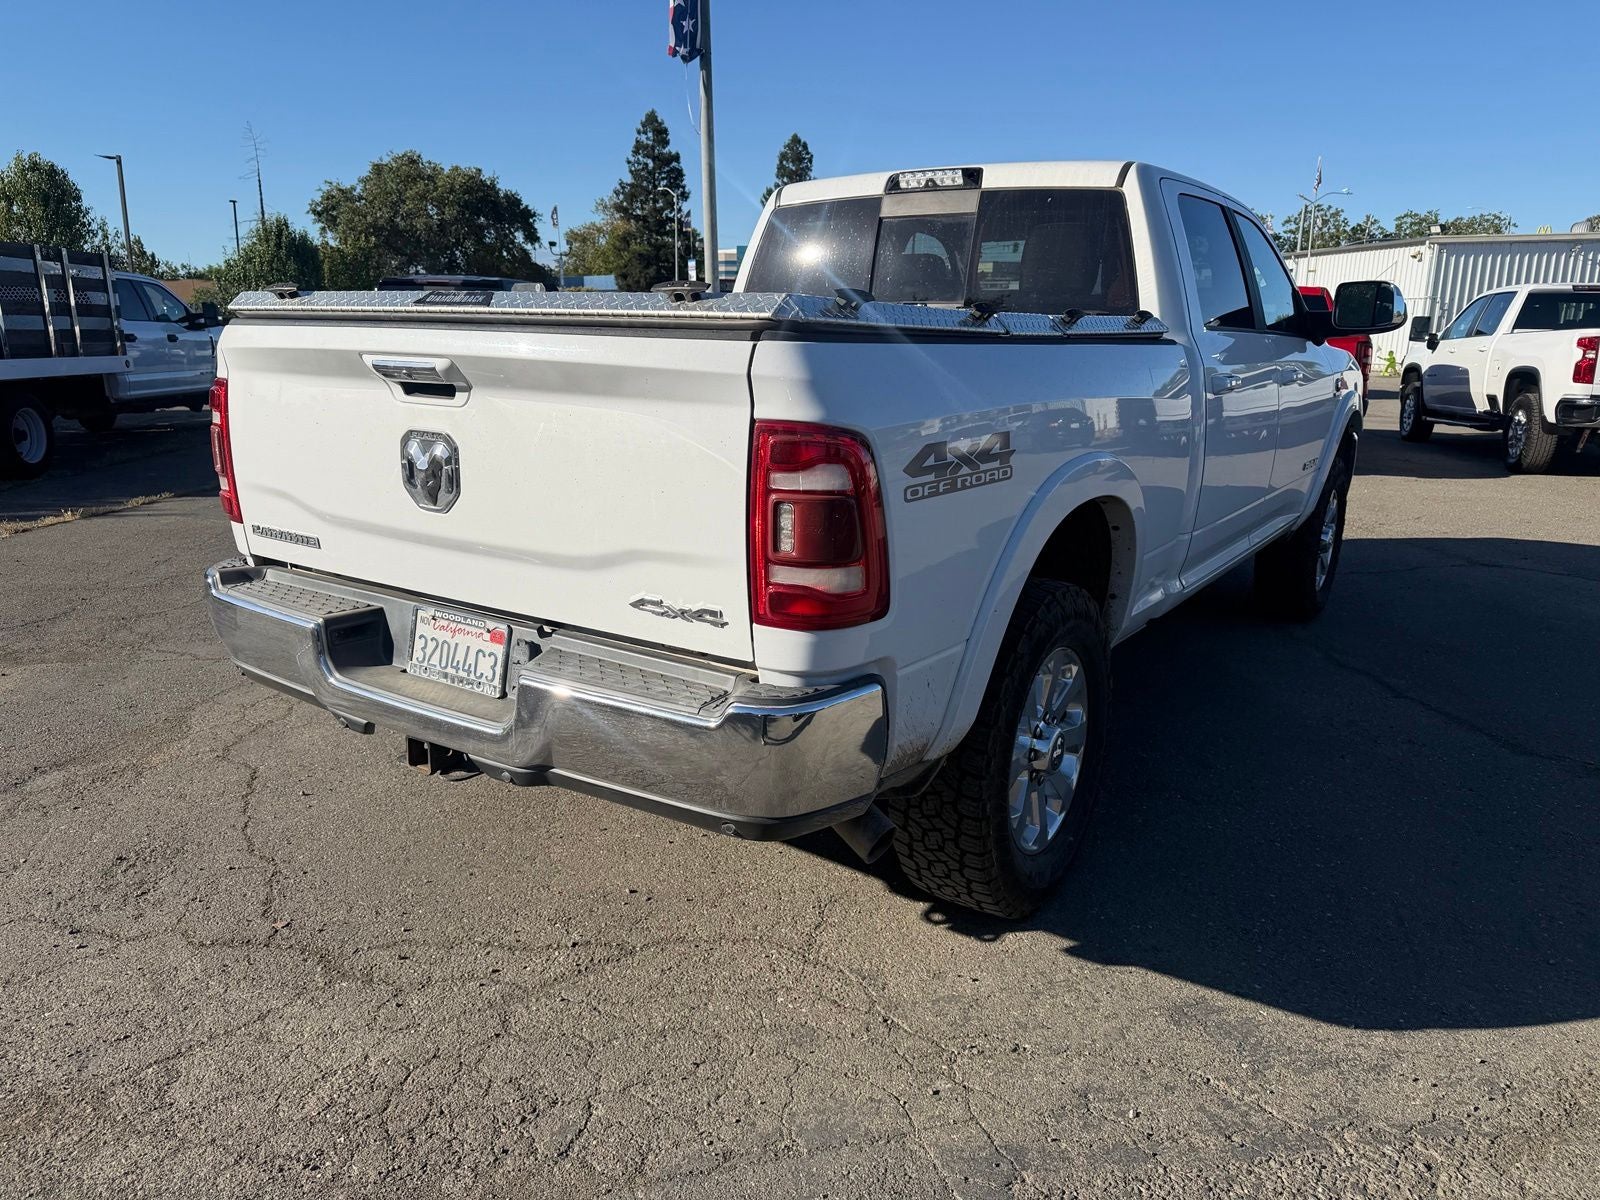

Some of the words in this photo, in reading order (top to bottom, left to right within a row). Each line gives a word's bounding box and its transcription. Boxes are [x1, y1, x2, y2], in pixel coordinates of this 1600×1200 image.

[906, 479, 952, 500] OFF
[956, 467, 1011, 489] ROAD
[419, 615, 432, 627] NOV
[432, 619, 489, 642] California
[434, 610, 485, 628] WOODLAND
[415, 633, 498, 684] 32044C3
